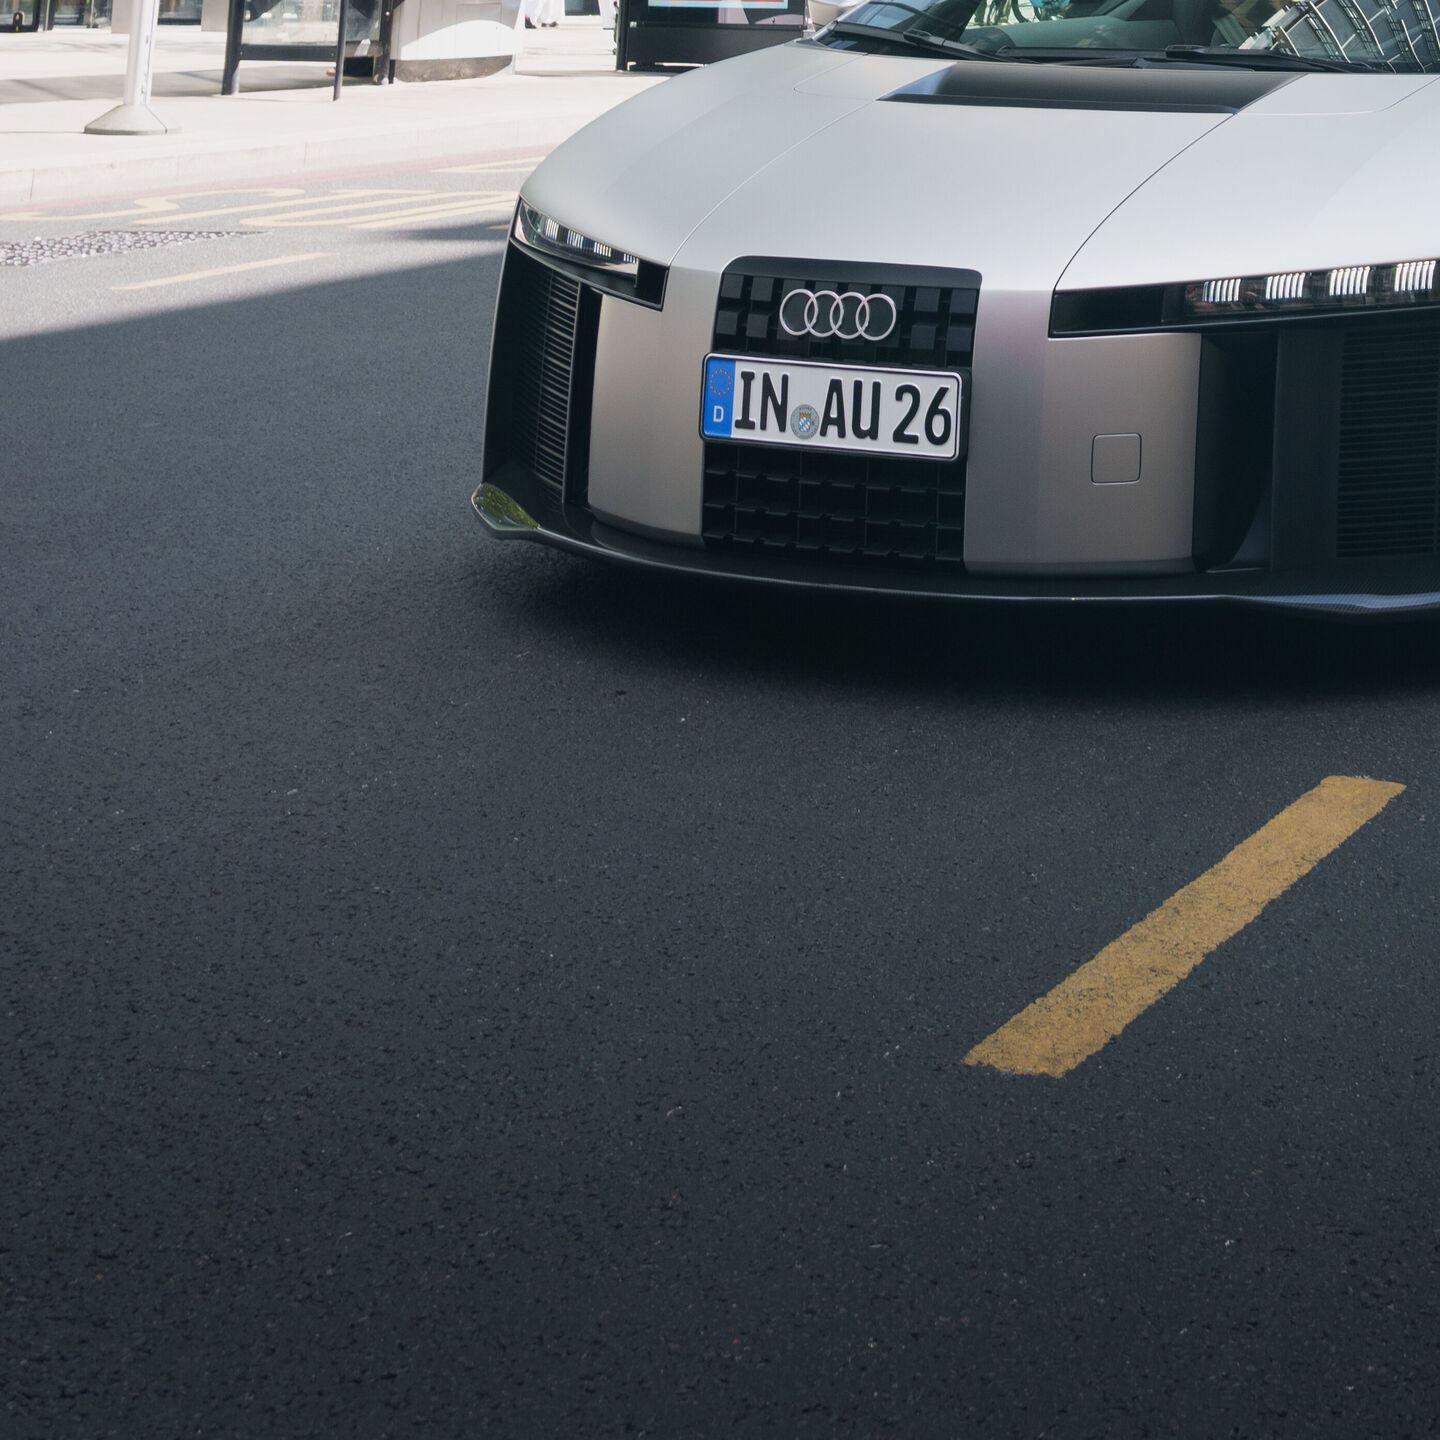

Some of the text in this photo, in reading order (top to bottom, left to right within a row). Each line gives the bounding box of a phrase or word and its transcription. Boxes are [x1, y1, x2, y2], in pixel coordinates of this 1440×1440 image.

[712, 405, 725, 423] D
[734, 370, 789, 433] IN
[819, 377, 882, 441] AU
[892, 383, 953, 446] 26
